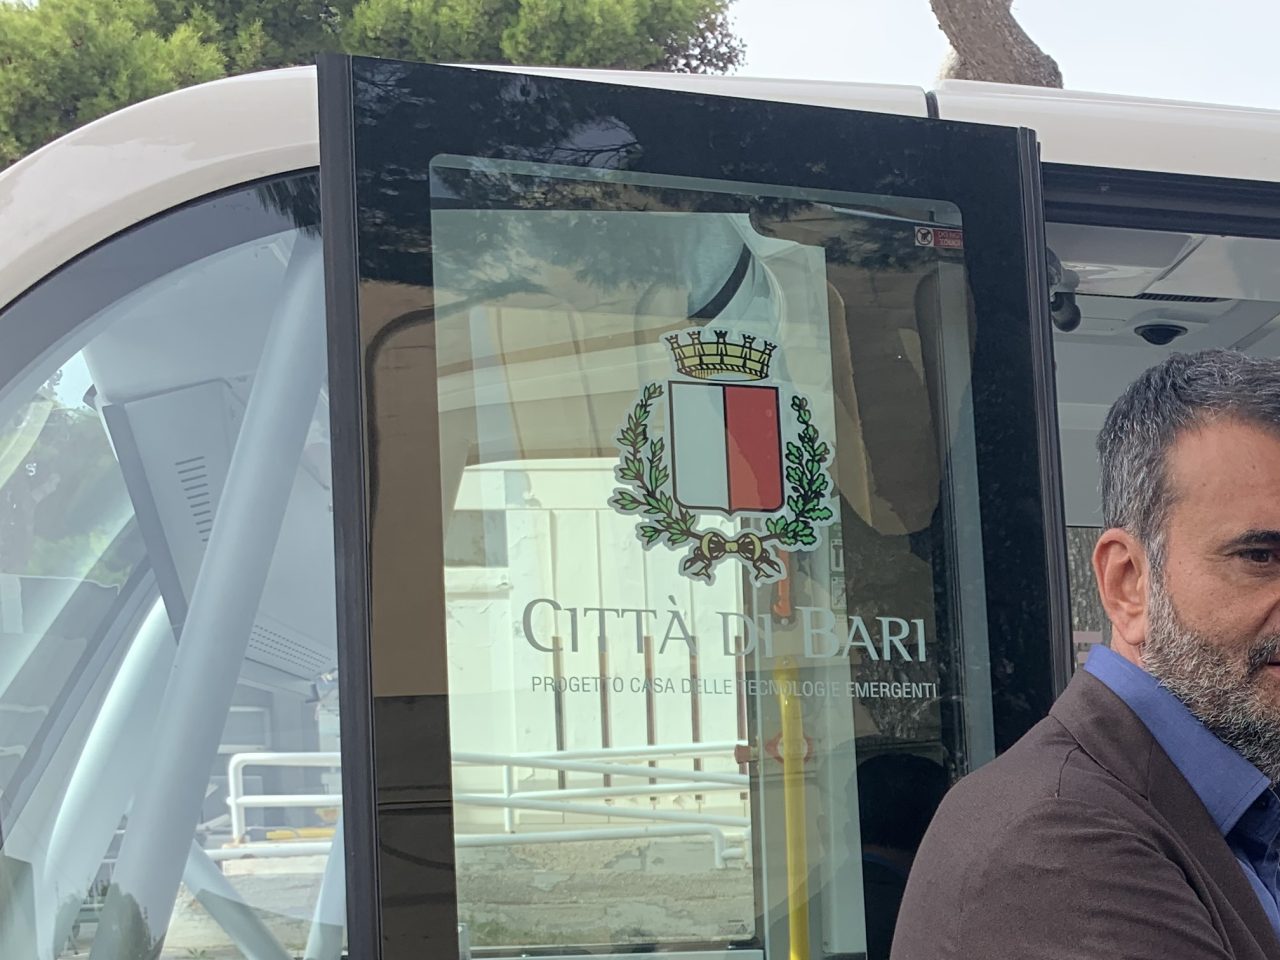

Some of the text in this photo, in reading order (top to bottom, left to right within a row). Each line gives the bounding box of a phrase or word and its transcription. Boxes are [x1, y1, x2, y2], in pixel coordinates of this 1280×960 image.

[531, 675, 939, 700] PROGETTO CASA DELLE TECNOLOGIE EMERGENTI
